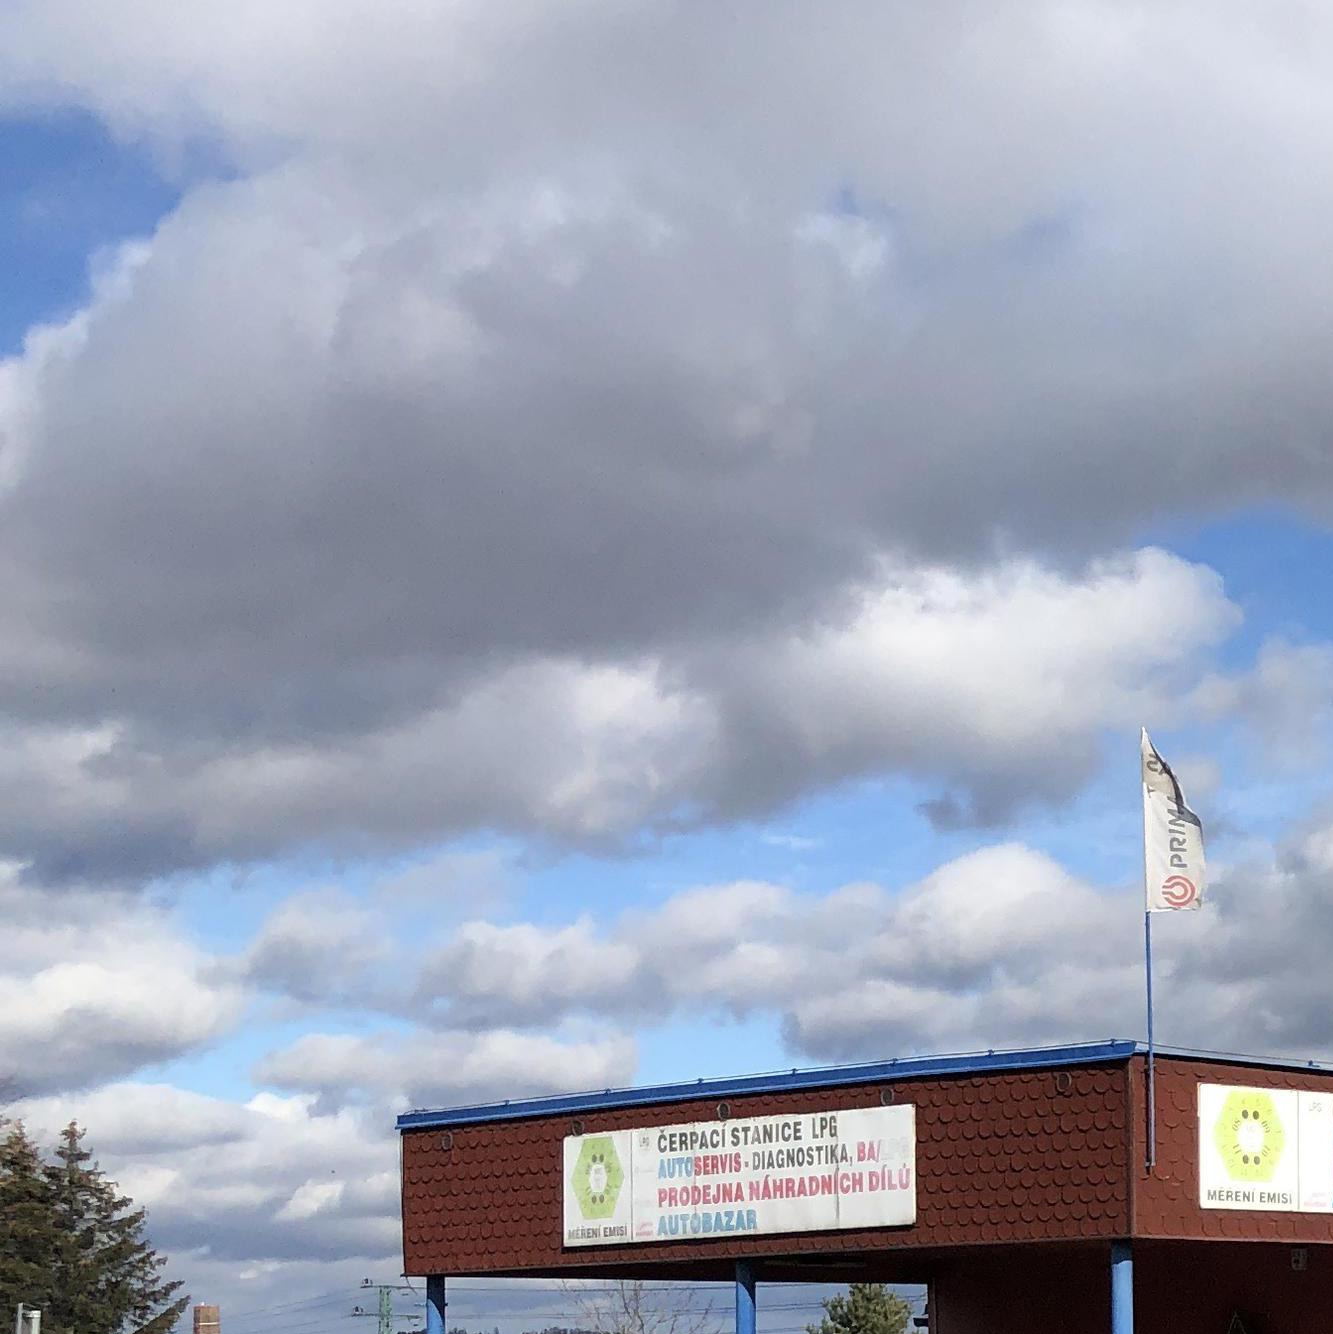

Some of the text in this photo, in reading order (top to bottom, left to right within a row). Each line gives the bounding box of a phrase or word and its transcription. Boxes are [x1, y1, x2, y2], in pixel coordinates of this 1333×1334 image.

[657, 1115, 838, 1154] ČERPACÍ STANICE LPG
[658, 1151, 742, 1180] AUTOSERVIS
[752, 1143, 853, 1171] DIAGNOSTIKA,
[658, 1181, 745, 1208] PRODEJNA
[749, 1168, 864, 1201] NÁHRADNÍCH
[657, 1209, 758, 1237] AUTOBAZAR
